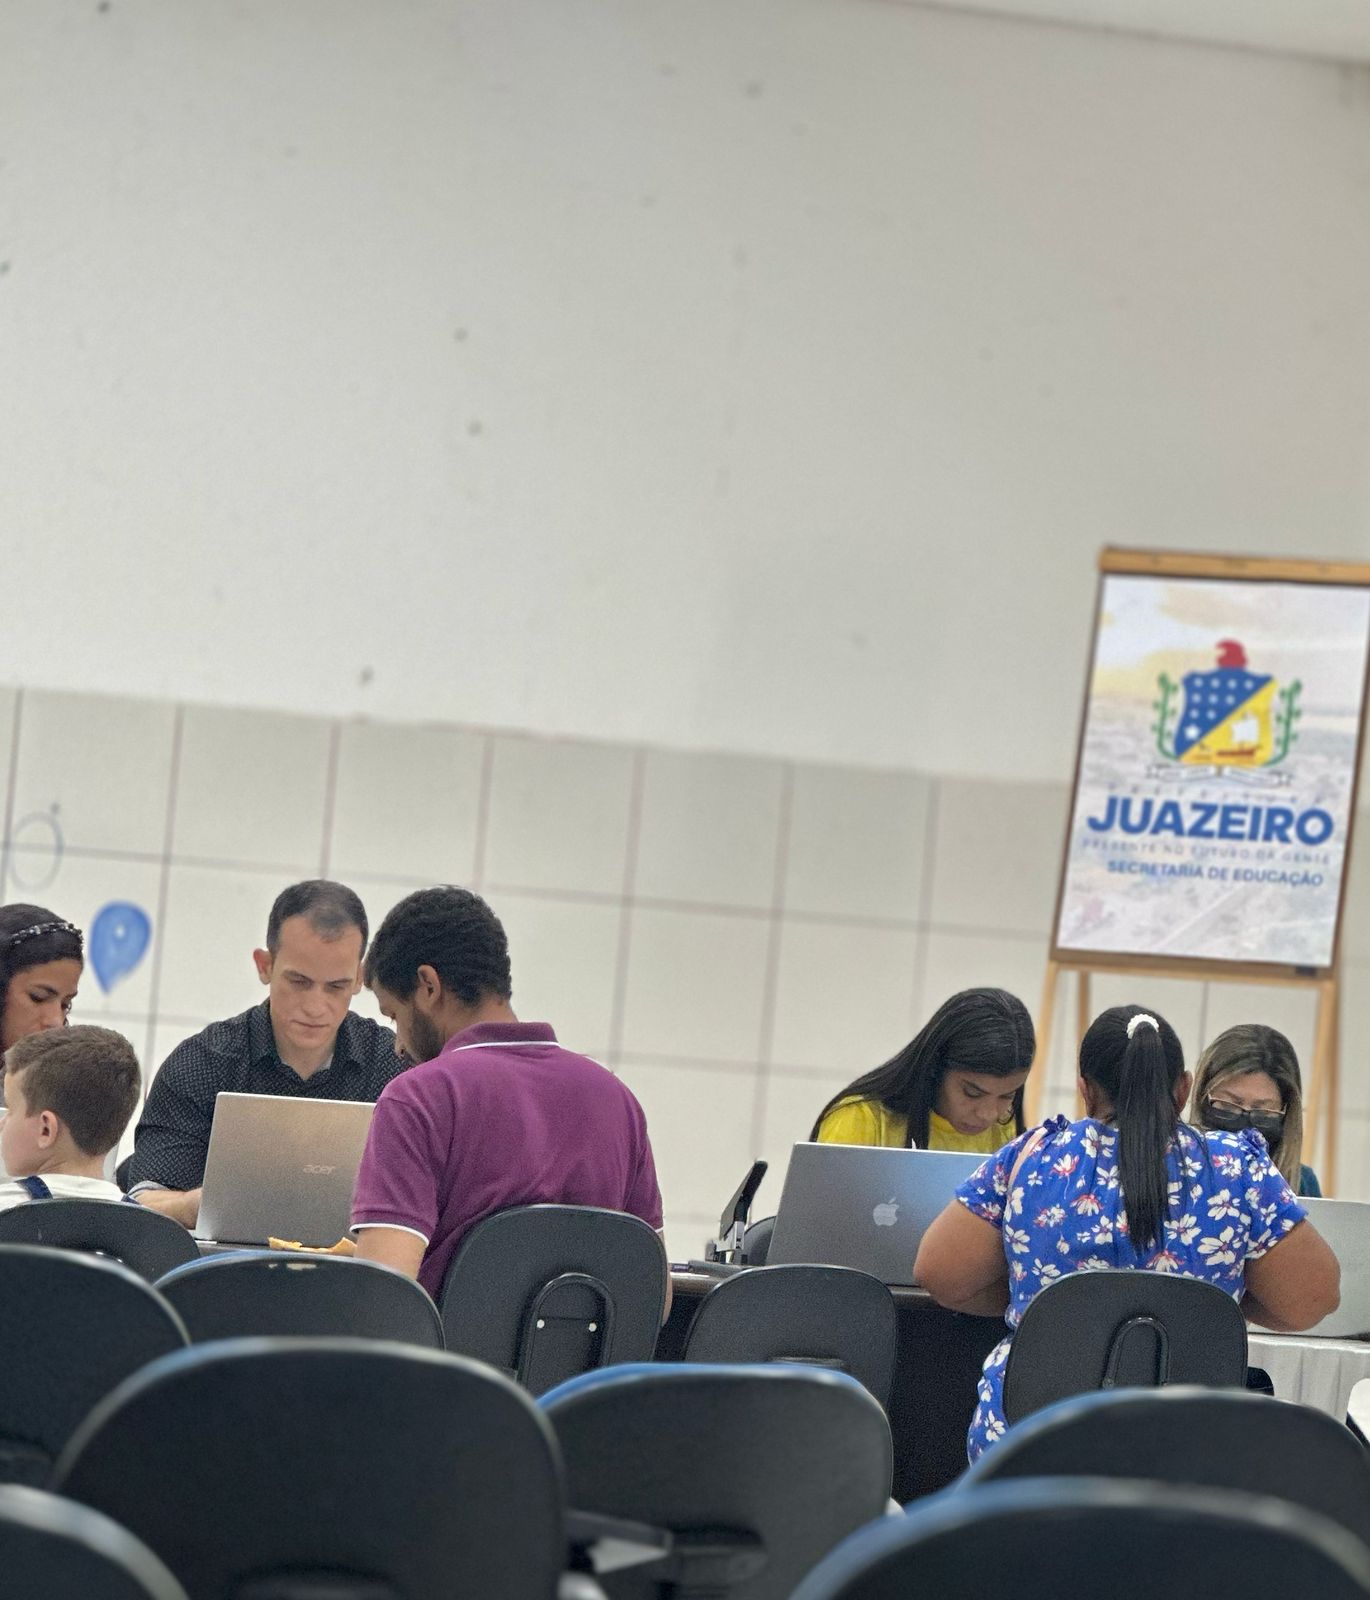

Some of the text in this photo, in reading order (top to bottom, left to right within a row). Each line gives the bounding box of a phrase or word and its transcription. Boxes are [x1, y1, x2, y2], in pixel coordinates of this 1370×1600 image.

[1087, 795, 1334, 846] JUAZEIRO
[1107, 860, 1325, 888] SECRETARIA DE EDUCAÇÃO
[302, 1164, 335, 1175] acer
